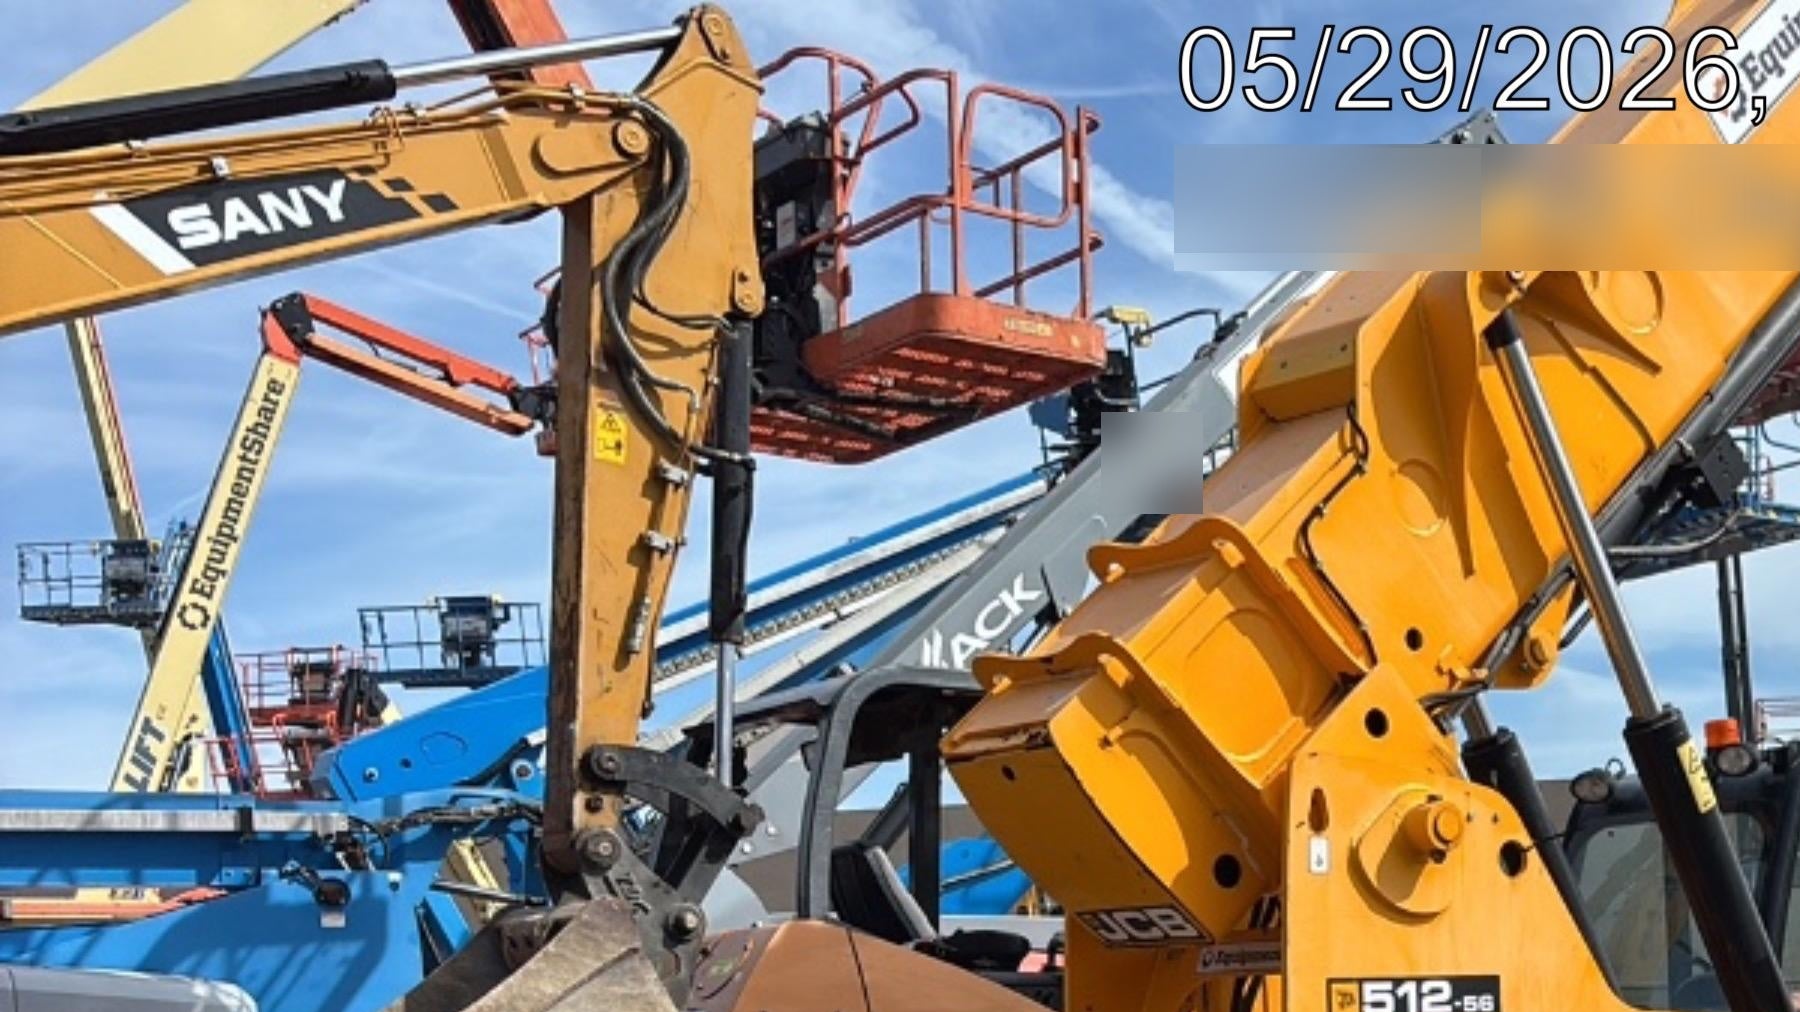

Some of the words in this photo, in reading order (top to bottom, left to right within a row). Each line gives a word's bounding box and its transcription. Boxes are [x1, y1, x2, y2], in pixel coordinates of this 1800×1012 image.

[167, 179, 346, 249] SANY
[189, 378, 285, 600] EquipmentShare
[122, 716, 166, 792] LIFT
[1097, 907, 1203, 941] JCB
